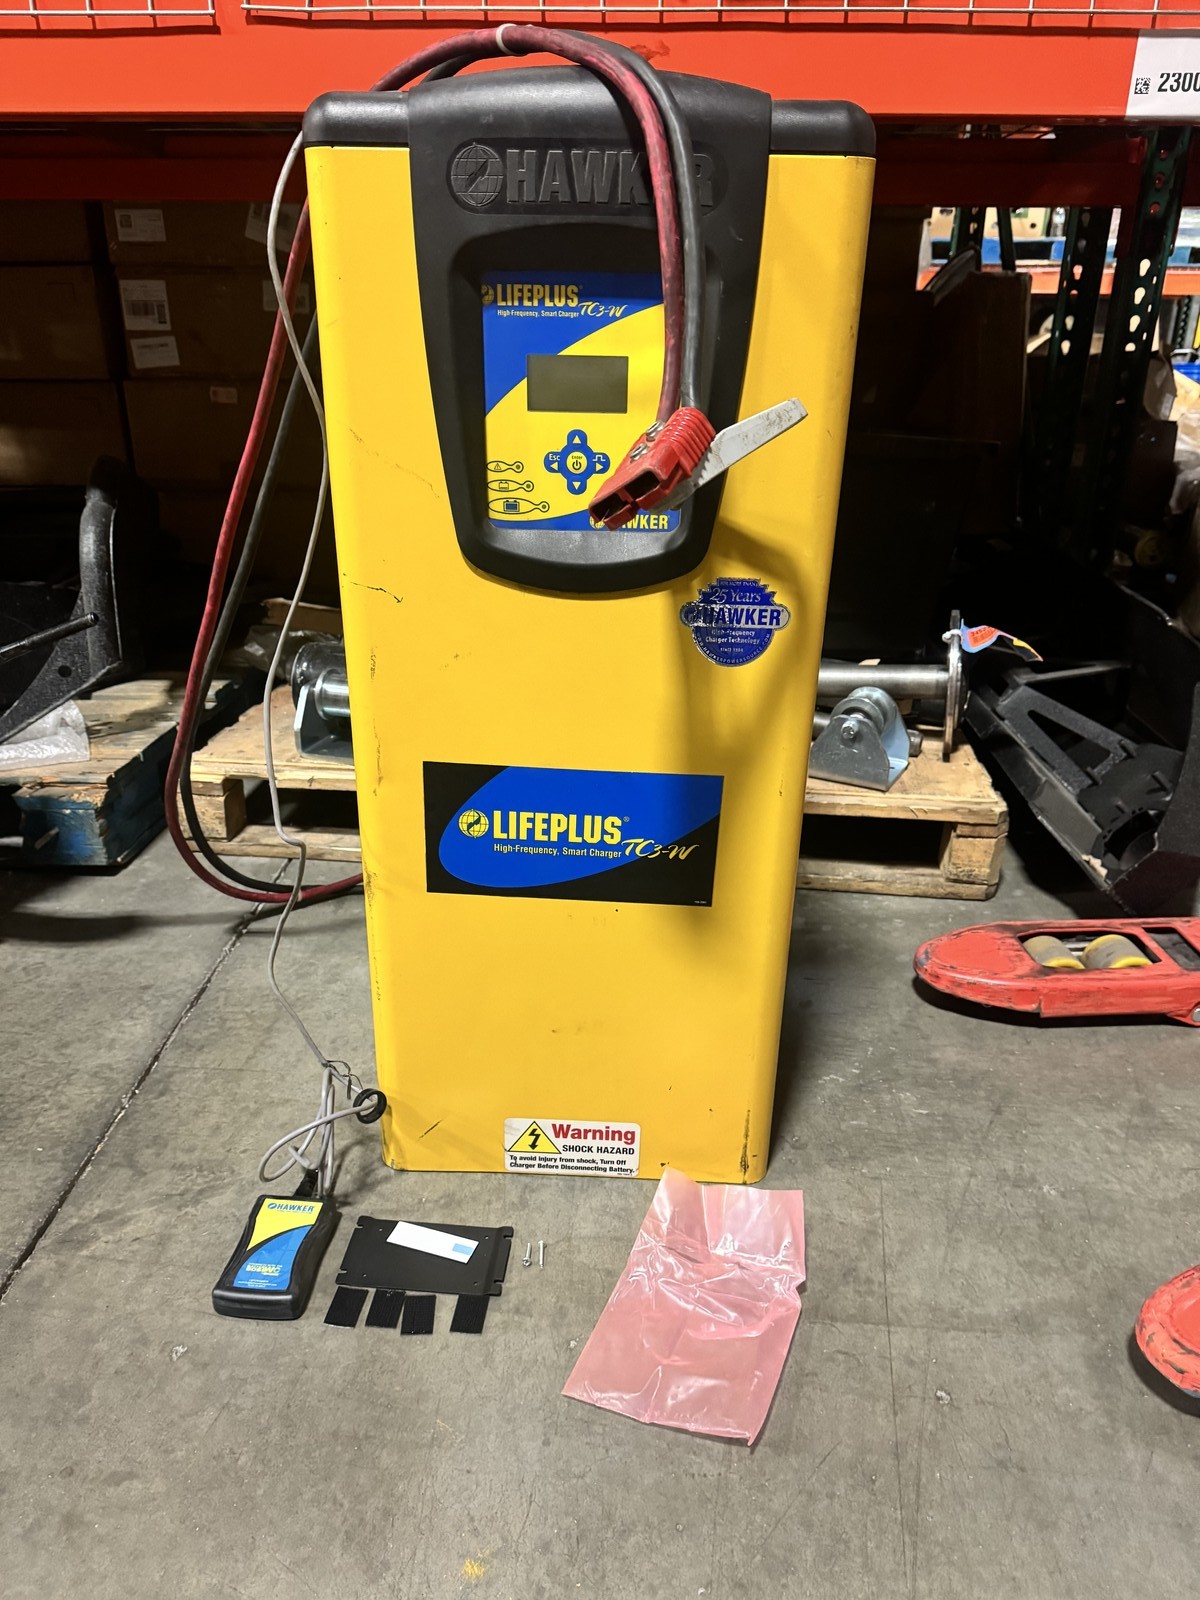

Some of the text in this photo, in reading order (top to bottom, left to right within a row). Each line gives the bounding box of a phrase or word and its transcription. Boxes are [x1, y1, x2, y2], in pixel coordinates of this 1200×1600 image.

[506, 149, 713, 207] HAWKR
[497, 283, 579, 307] LIFEPLUS
[558, 310, 579, 319] Charger
[578, 301, 628, 317] TC3-W
[548, 453, 561, 461] Esc
[621, 514, 669, 529] WKER
[709, 587, 761, 604] 25 Years
[703, 606, 781, 626] HAWKER
[705, 636, 760, 645] Charger Technology
[493, 809, 622, 845] LIFEPLUS
[493, 843, 622, 859] High-Frequency, Smart Charger
[621, 838, 700, 860] TC3-W
[552, 1123, 636, 1145] Warning
[562, 1144, 635, 1155] SHOCK HAZARD
[509, 1162, 536, 1170] Charger
[560, 1164, 608, 1173] Disconnecting
[608, 1166, 635, 1174] Battery.
[538, 1156, 558, 1164] injury
[576, 1157, 599, 1165] shock,
[276, 1203, 315, 1213] HAWKER
